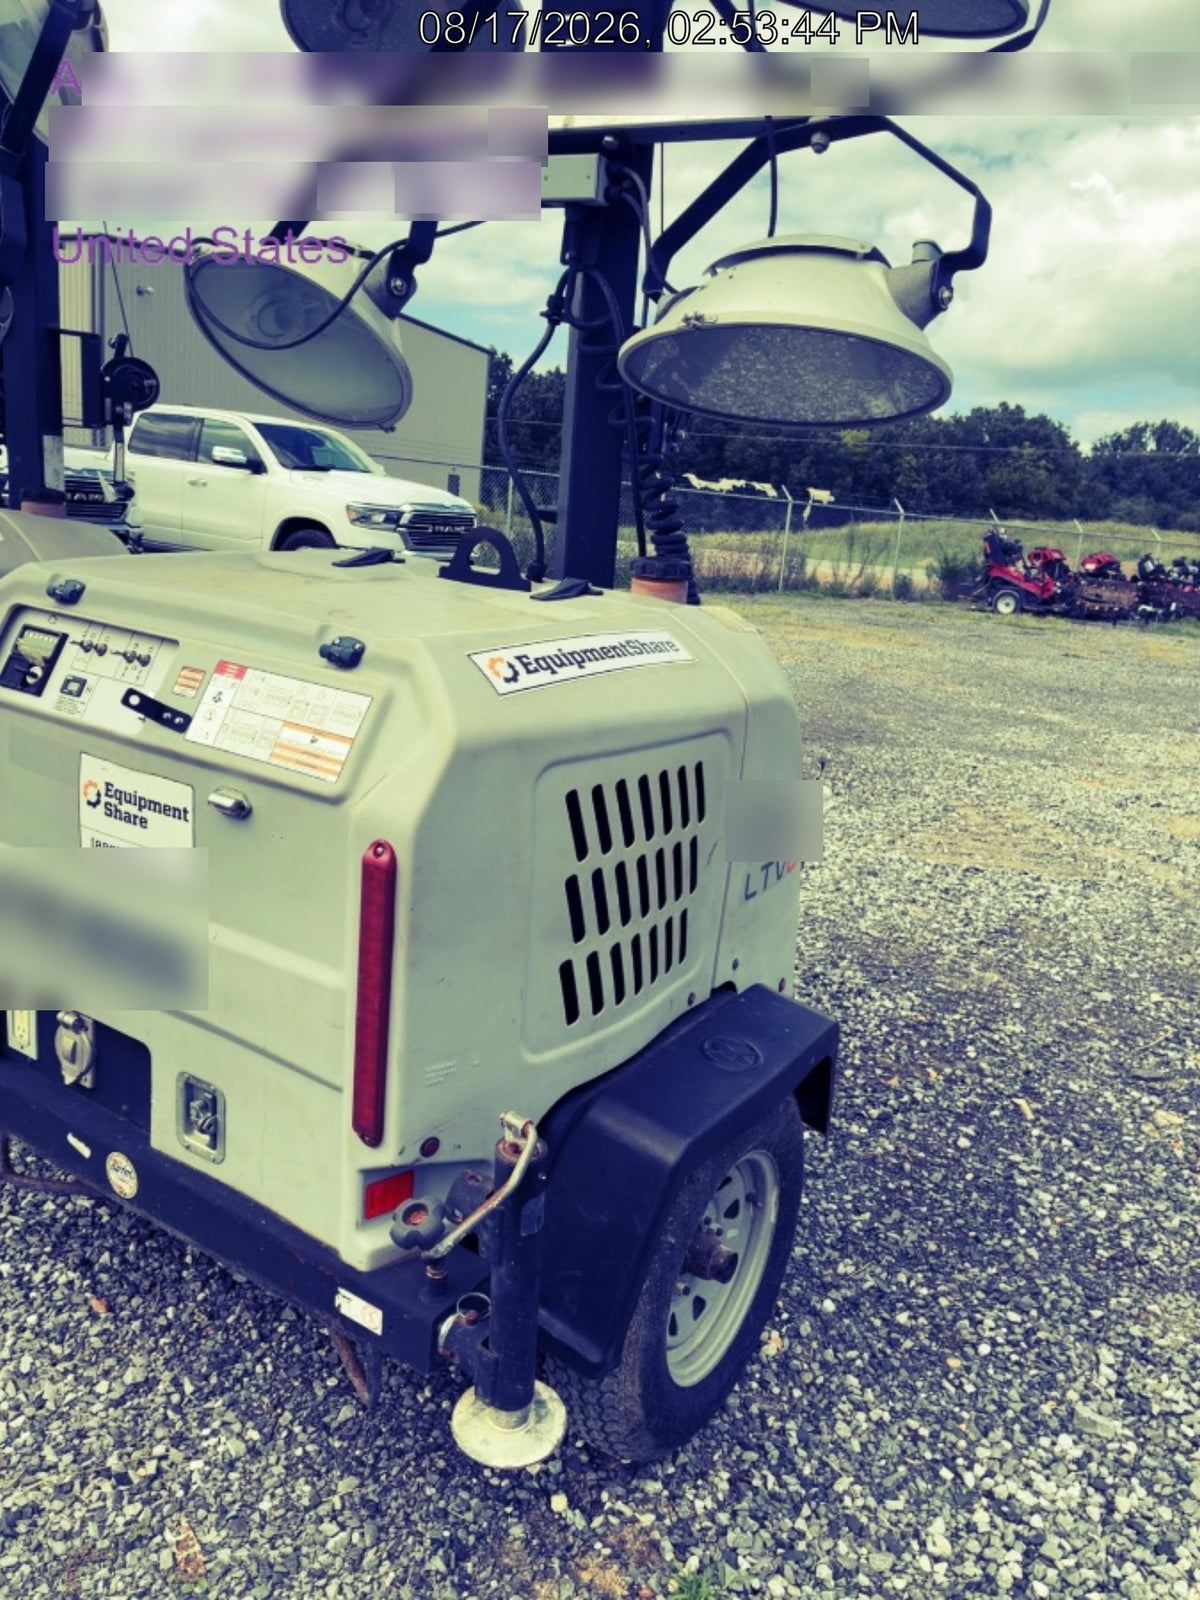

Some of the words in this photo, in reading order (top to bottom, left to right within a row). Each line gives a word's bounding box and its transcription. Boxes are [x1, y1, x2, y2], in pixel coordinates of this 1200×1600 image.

[514, 639, 680, 675] EquipmentShare
[103, 801, 149, 829] Share
[104, 781, 190, 823] Equipment
